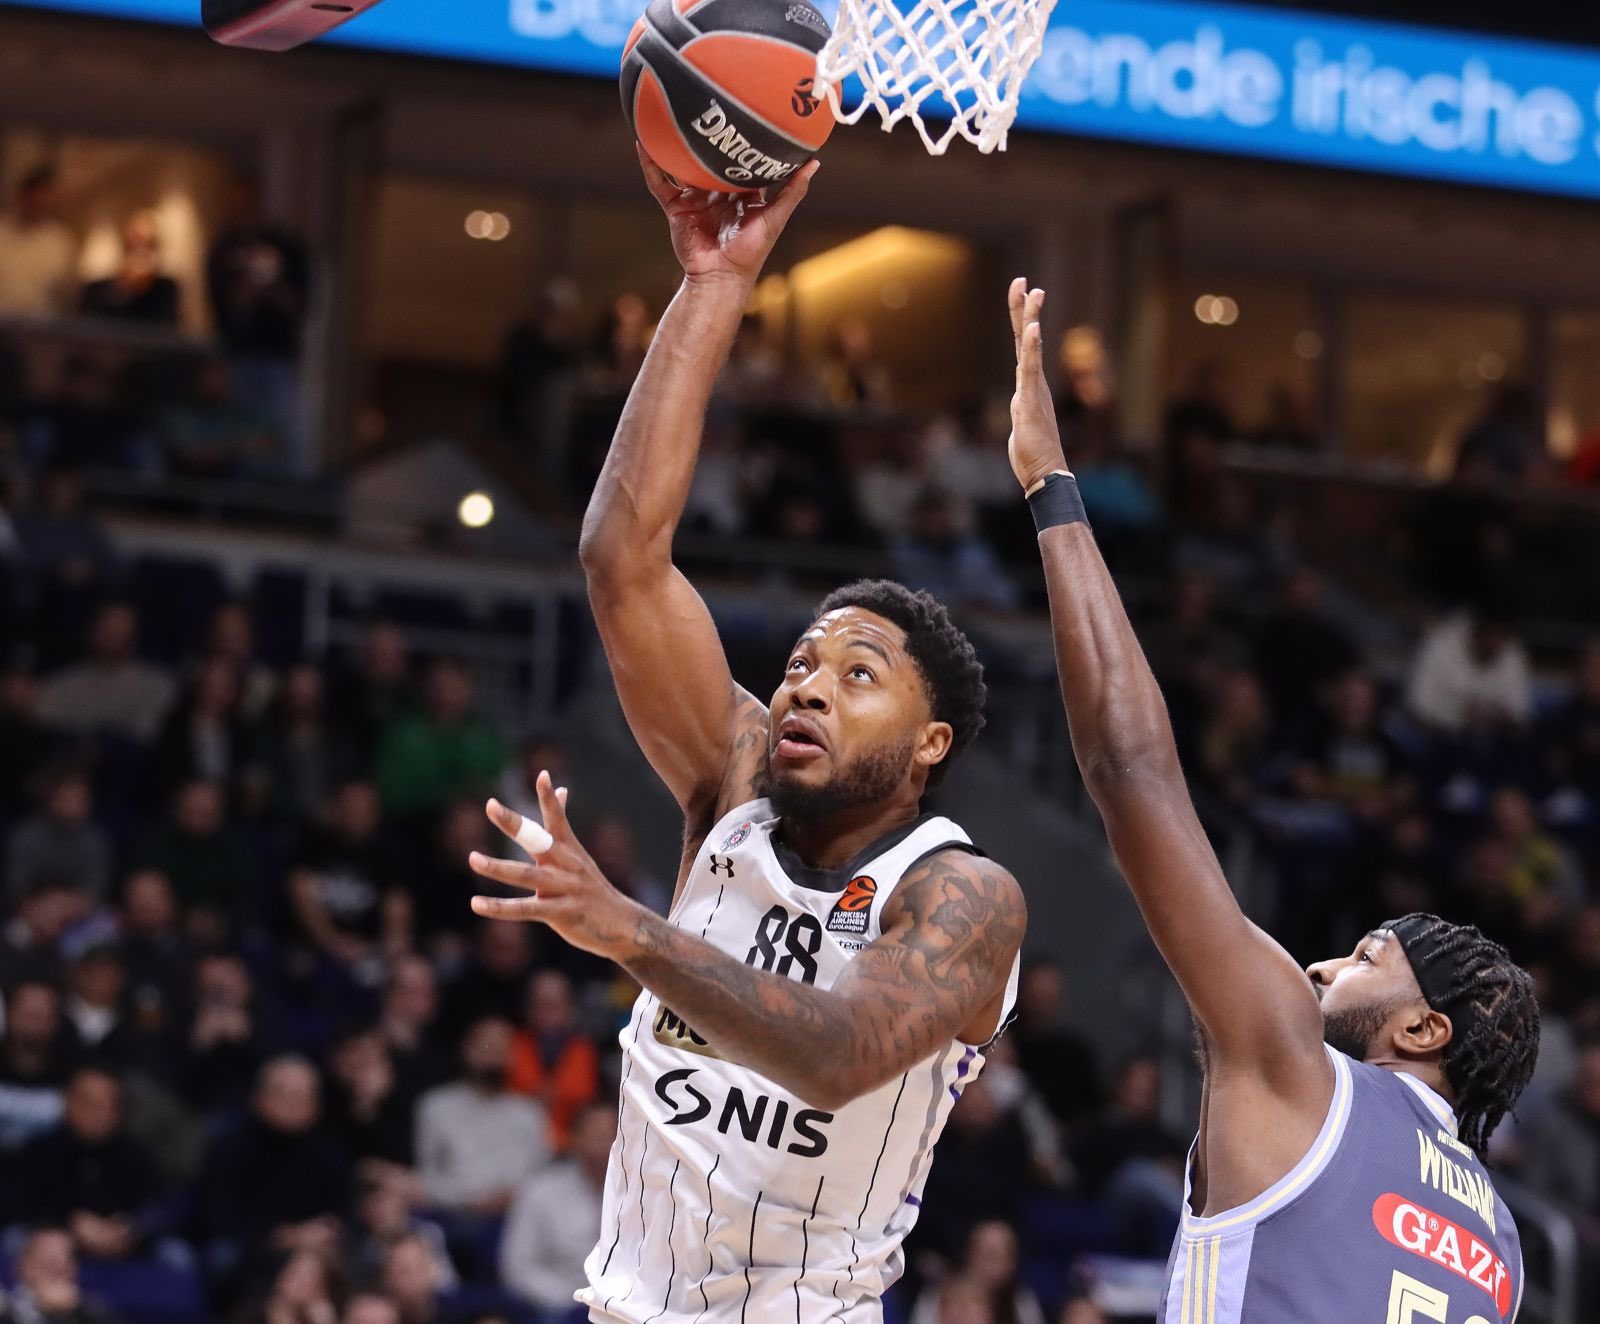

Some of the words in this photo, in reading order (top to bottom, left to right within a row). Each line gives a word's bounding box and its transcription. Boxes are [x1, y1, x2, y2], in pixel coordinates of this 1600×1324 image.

[1291, 36, 1584, 165] irische
[744, 904, 823, 986] 88
[830, 917, 866, 926] AIRLINES
[833, 911, 867, 920] TURKISH
[717, 1086, 834, 1158] NIS
